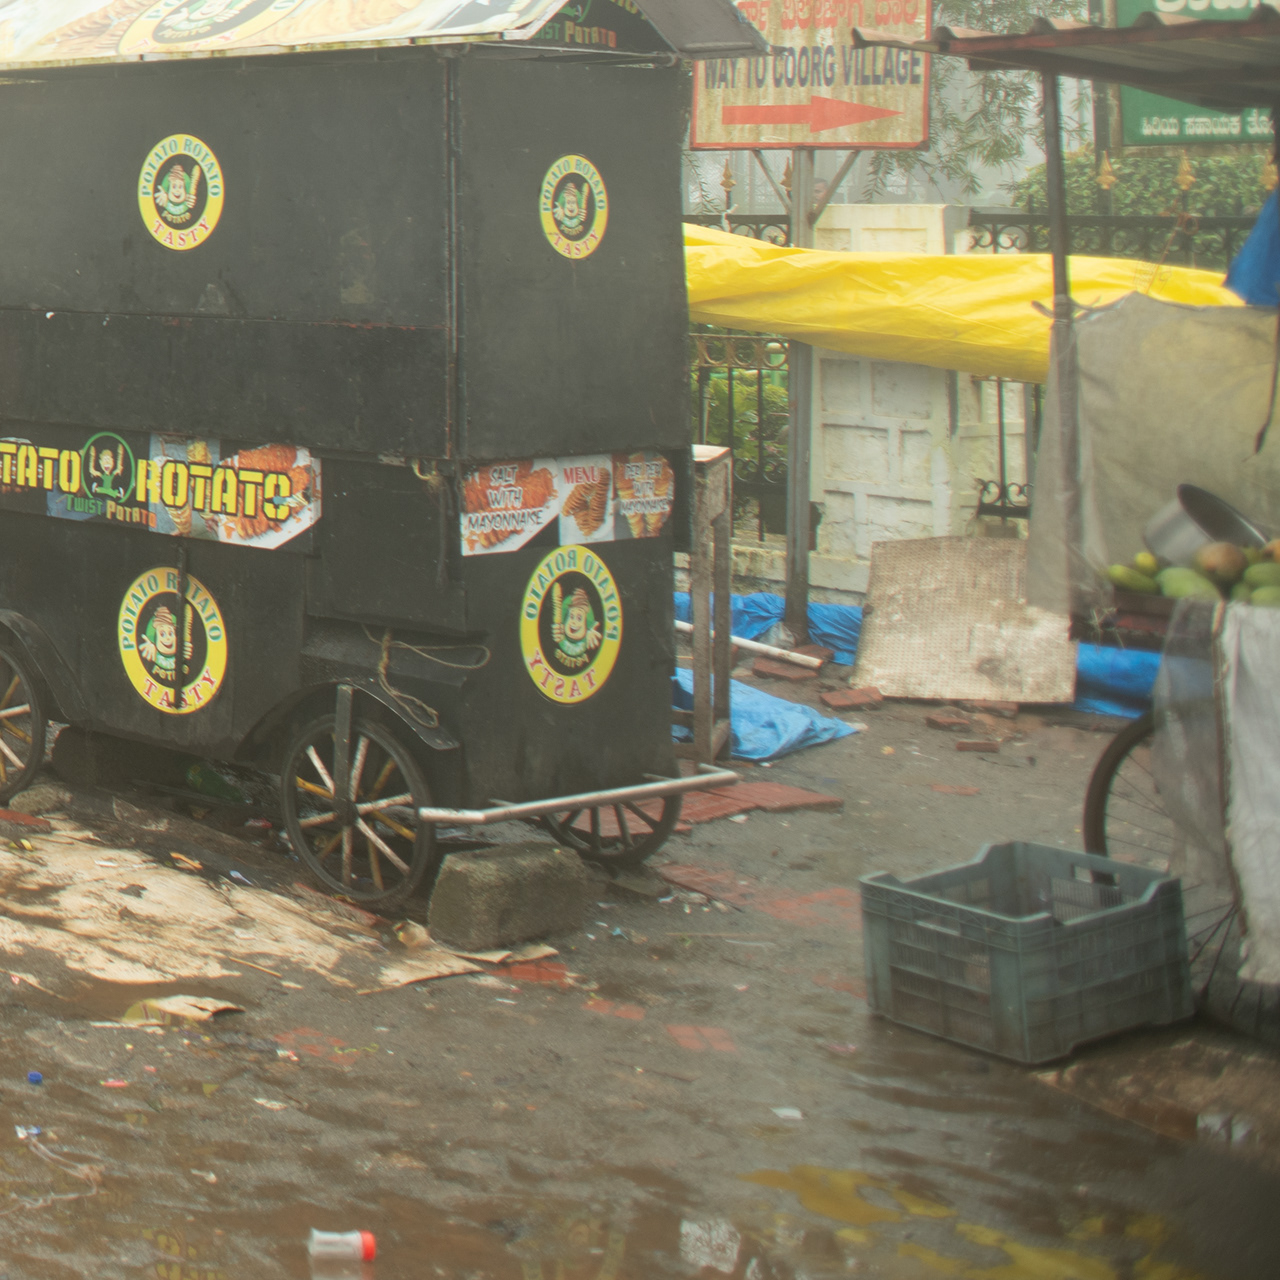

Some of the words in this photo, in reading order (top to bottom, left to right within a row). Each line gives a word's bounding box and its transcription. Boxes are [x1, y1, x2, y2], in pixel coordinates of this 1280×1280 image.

[564, 21, 617, 48] POTATO
[705, 59, 739, 89] WAY
[772, 45, 837, 88] COORG
[841, 46, 923, 86] VILLAGE
[141, 138, 179, 197] POTATO
[184, 138, 221, 197] ROTATO
[542, 159, 571, 212] POTATO
[575, 158, 606, 211] ROTATO
[153, 218, 210, 247] TASTY
[554, 230, 598, 256] TASTY
[135, 458, 293, 521] ROTATO
[489, 464, 519, 487] SALT
[563, 465, 601, 485] MENU
[66, 493, 103, 516] TWIST
[105, 500, 157, 528] POTATO
[487, 486, 523, 508] WITH
[122, 574, 160, 650] POTATO
